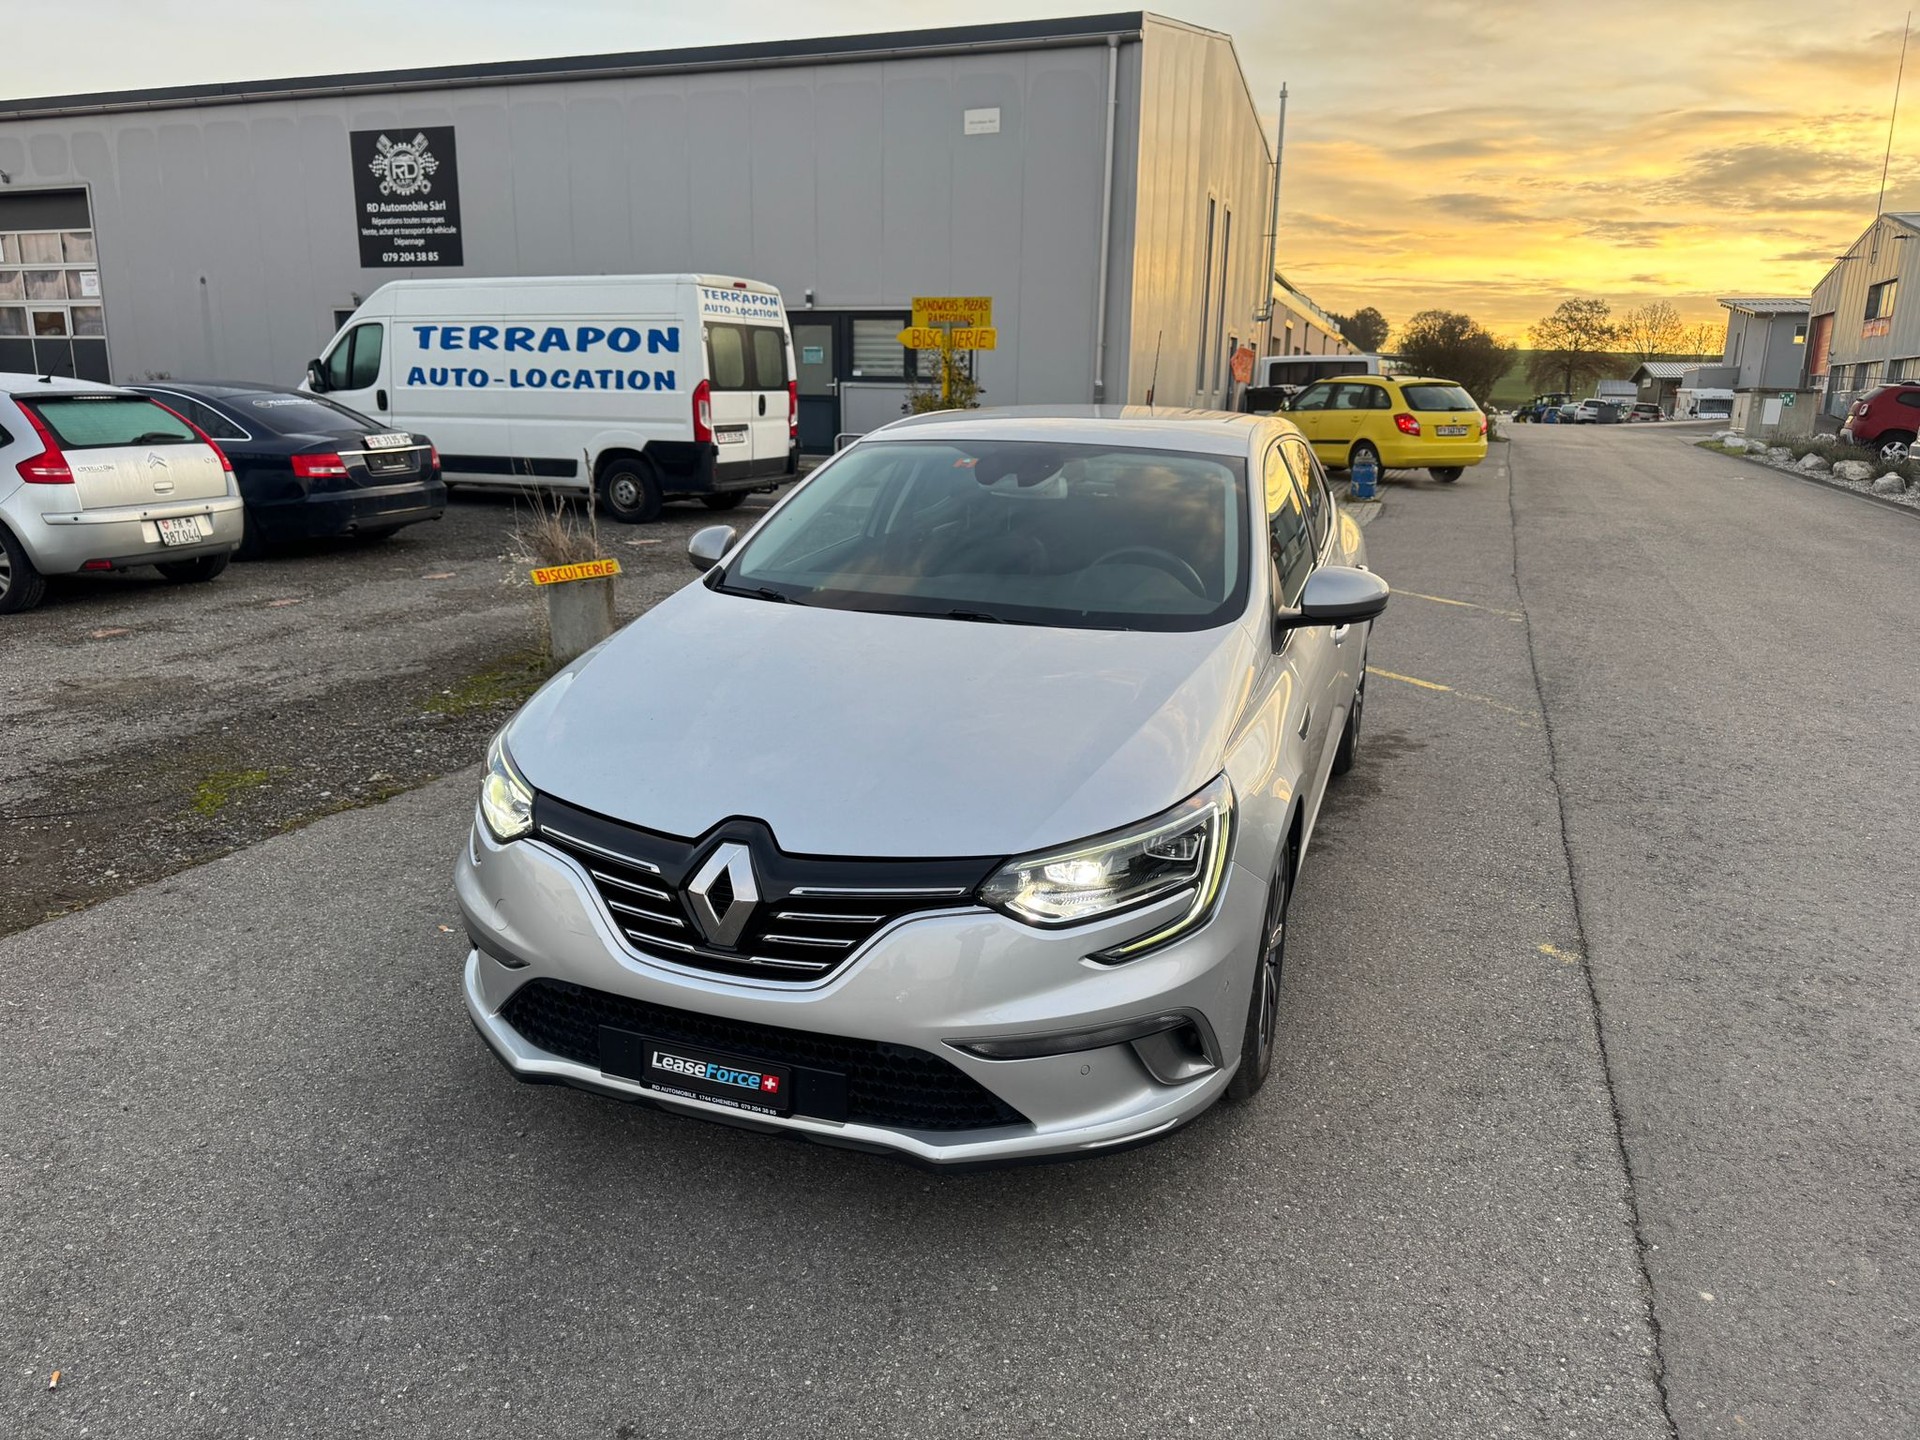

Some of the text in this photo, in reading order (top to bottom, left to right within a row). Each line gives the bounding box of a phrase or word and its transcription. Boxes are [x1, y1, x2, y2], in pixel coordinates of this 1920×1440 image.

[392, 162, 418, 178] RD
[366, 203, 378, 212] RD
[380, 201, 428, 212] Automobile
[372, 217, 402, 226] Réparations
[421, 217, 445, 225] marques
[379, 227, 394, 235] achat
[401, 227, 425, 236] transport
[426, 226, 433, 234] de
[433, 225, 456, 234] véhicule
[394, 238, 425, 246] Dépannage
[383, 252, 439, 262] 079 204 38 85
[702, 288, 778, 306] TERRAPON
[964, 300, 989, 311] PIZZAS
[412, 326, 680, 354] TERRAPON
[407, 366, 676, 390] AUTO-LOCATION
[172, 519, 184, 529] FR
[537, 562, 614, 582] BISCUITERIE
[652, 1051, 760, 1087] LeaseForce
[661, 1087, 696, 1099] AUTOMOBILE
[699, 1094, 711, 1102] 1744
[712, 1097, 739, 1108] CHENENS
